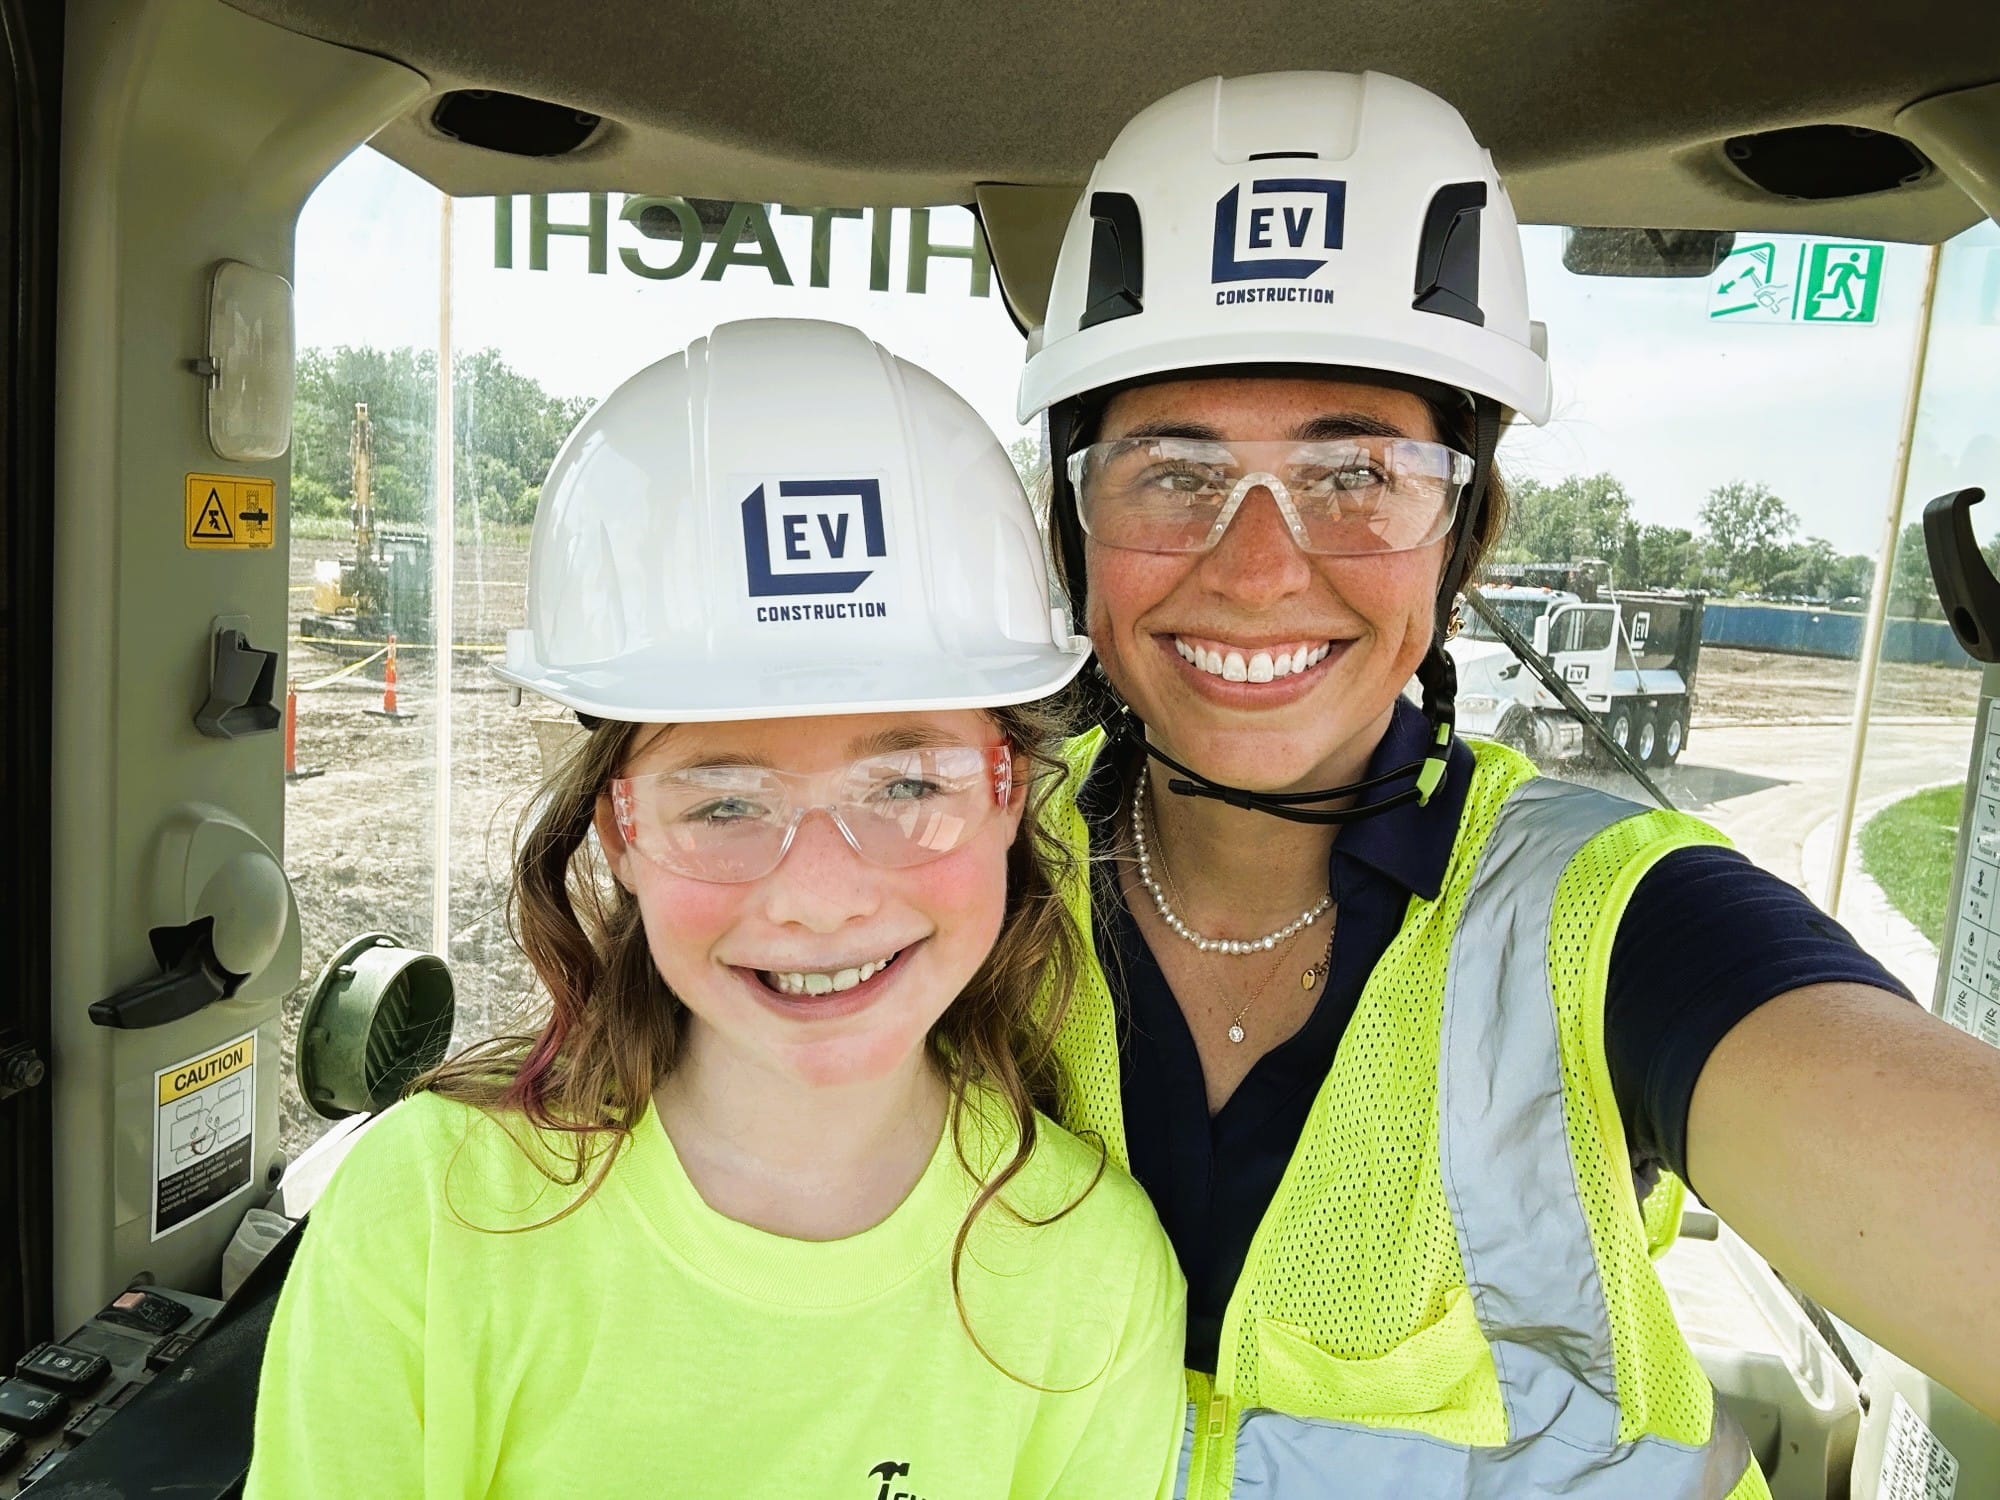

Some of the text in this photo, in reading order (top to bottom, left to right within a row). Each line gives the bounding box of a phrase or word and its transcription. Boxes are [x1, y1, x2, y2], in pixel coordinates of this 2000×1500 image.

[1249, 207, 1313, 249] EV
[1216, 287, 1334, 306] CONSTRUCTION
[783, 513, 849, 560] EV
[757, 602, 887, 622] CONSTRUCTION
[174, 1048, 243, 1092] CAUTION
